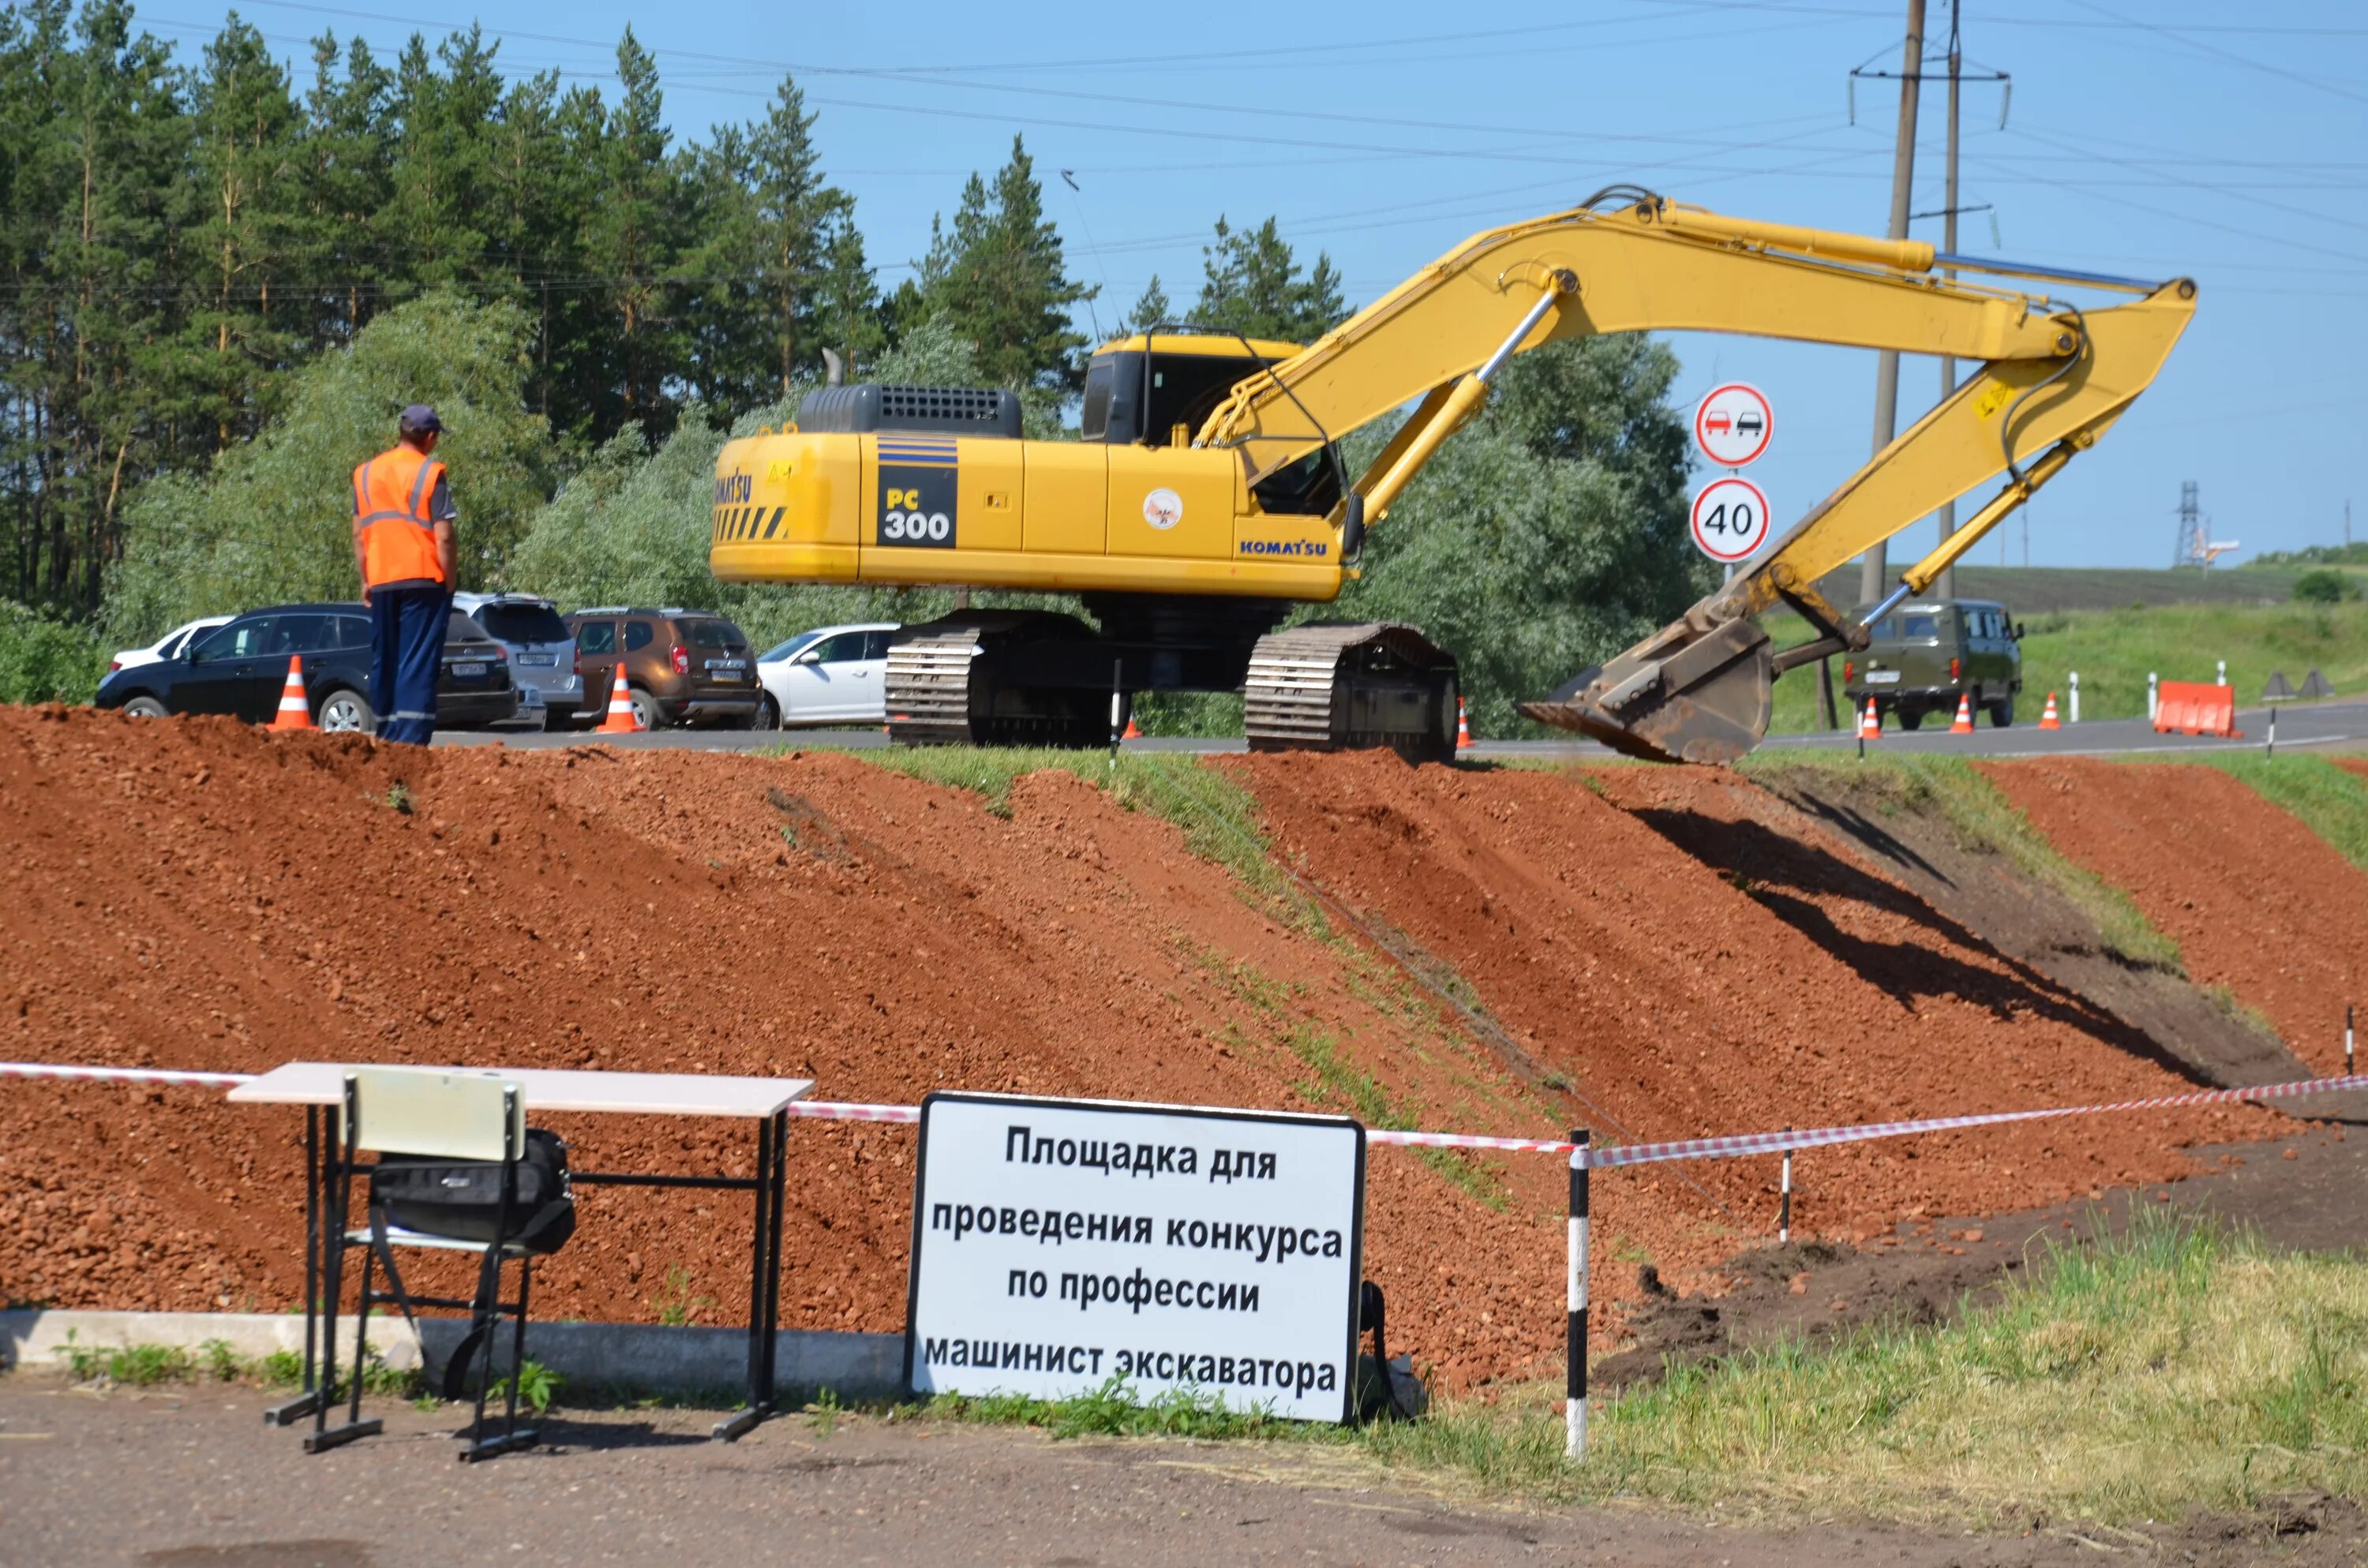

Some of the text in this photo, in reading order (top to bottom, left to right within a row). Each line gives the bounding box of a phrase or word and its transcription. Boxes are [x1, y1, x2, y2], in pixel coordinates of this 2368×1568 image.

[886, 488, 919, 511] PC
[884, 511, 950, 541] 300
[1705, 504, 1752, 535] 40
[1240, 539, 1328, 556] KOMATSU
[1006, 1126, 1276, 1184] Площадка для
[932, 1203, 1342, 1263] проведения конкурса
[1008, 1267, 1259, 1314] по профессии
[924, 1338, 1336, 1399] машинист экскаватора
